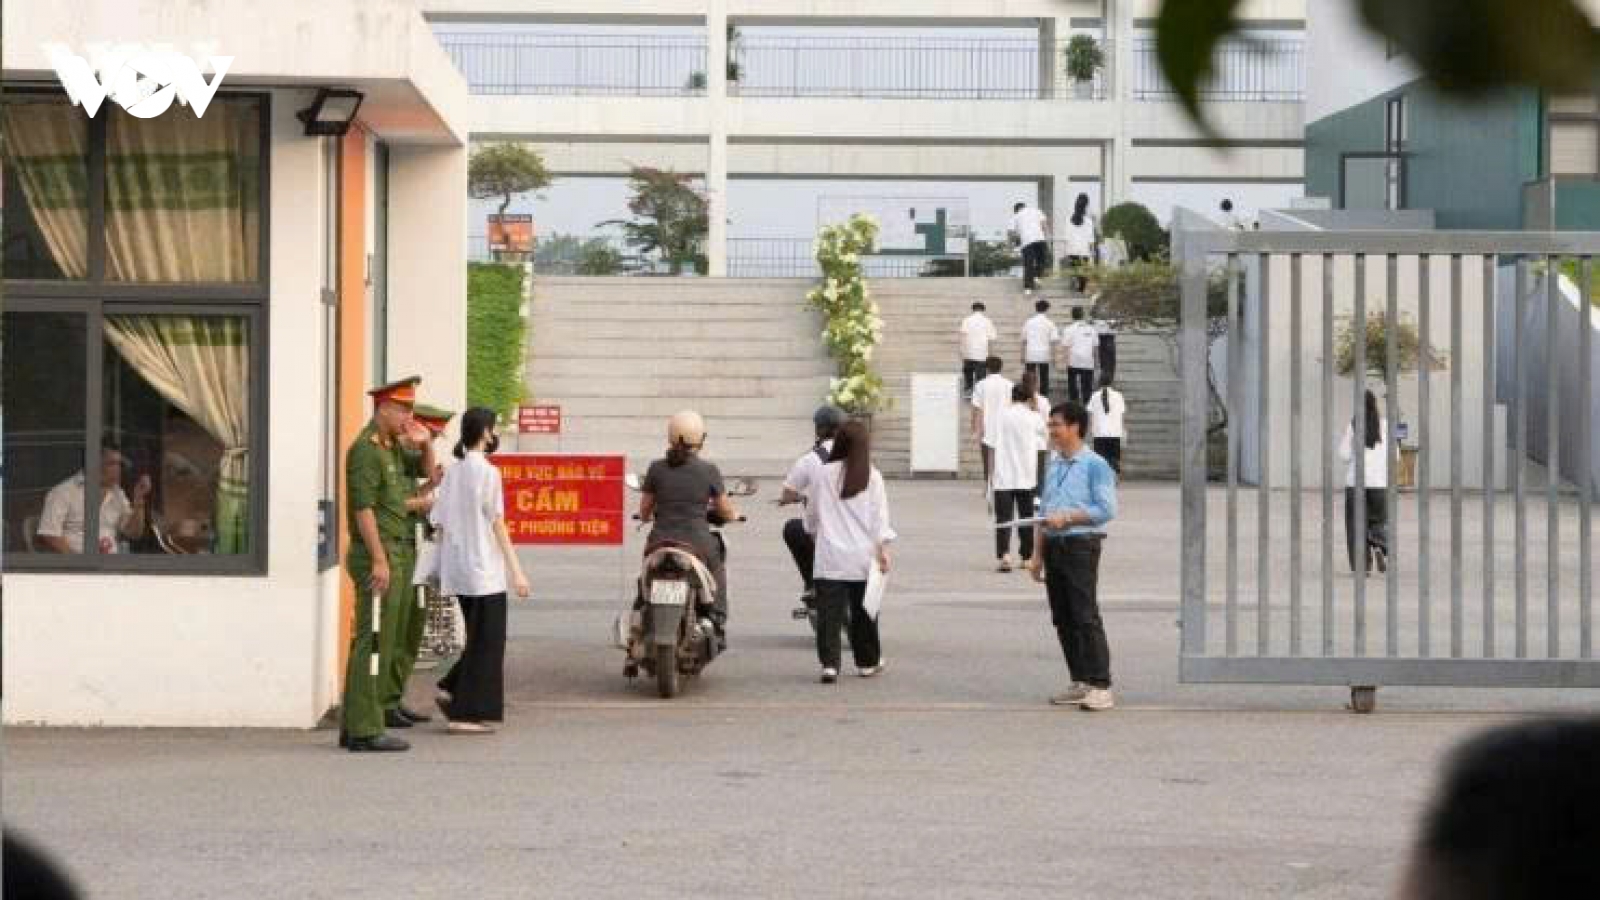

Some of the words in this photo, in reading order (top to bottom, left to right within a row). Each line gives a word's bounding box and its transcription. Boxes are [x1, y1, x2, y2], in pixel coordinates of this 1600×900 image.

[502, 465, 522, 479] HU
[516, 486, 580, 512] CẤM
[520, 518, 575, 534] PHƯƠNG
[579, 518, 609, 536] TIỆN
